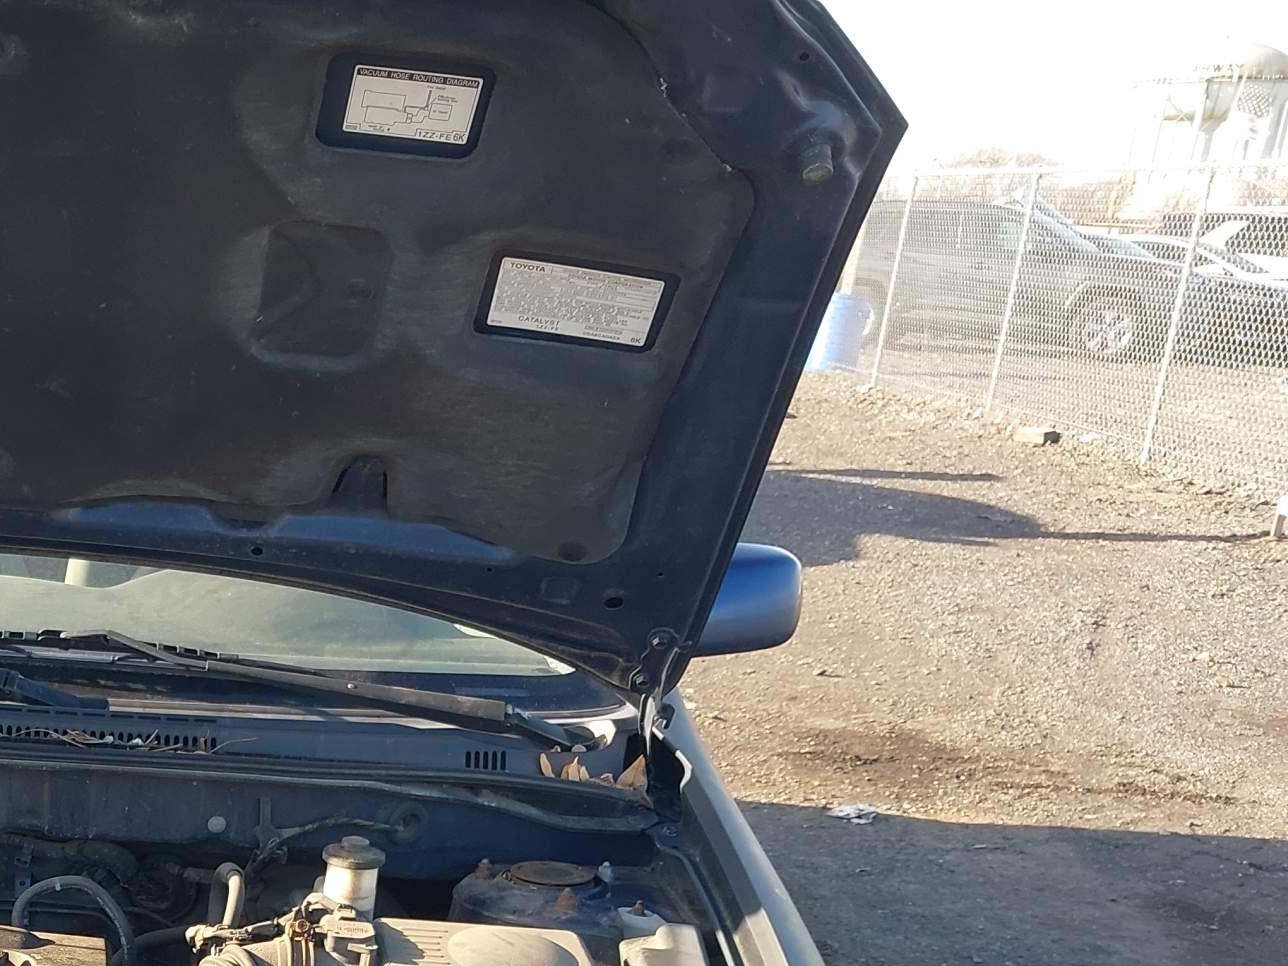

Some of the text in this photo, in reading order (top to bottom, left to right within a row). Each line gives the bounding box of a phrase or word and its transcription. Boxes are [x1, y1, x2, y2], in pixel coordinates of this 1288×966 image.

[360, 69, 388, 78] VACUUM
[391, 72, 410, 80] HOSE
[413, 74, 444, 84] ROUTING
[447, 78, 478, 88] DIAGRAM
[418, 131, 451, 142] 1ZZ-FE
[510, 262, 546, 273] TOYOTA
[518, 315, 561, 325] CATALYST
